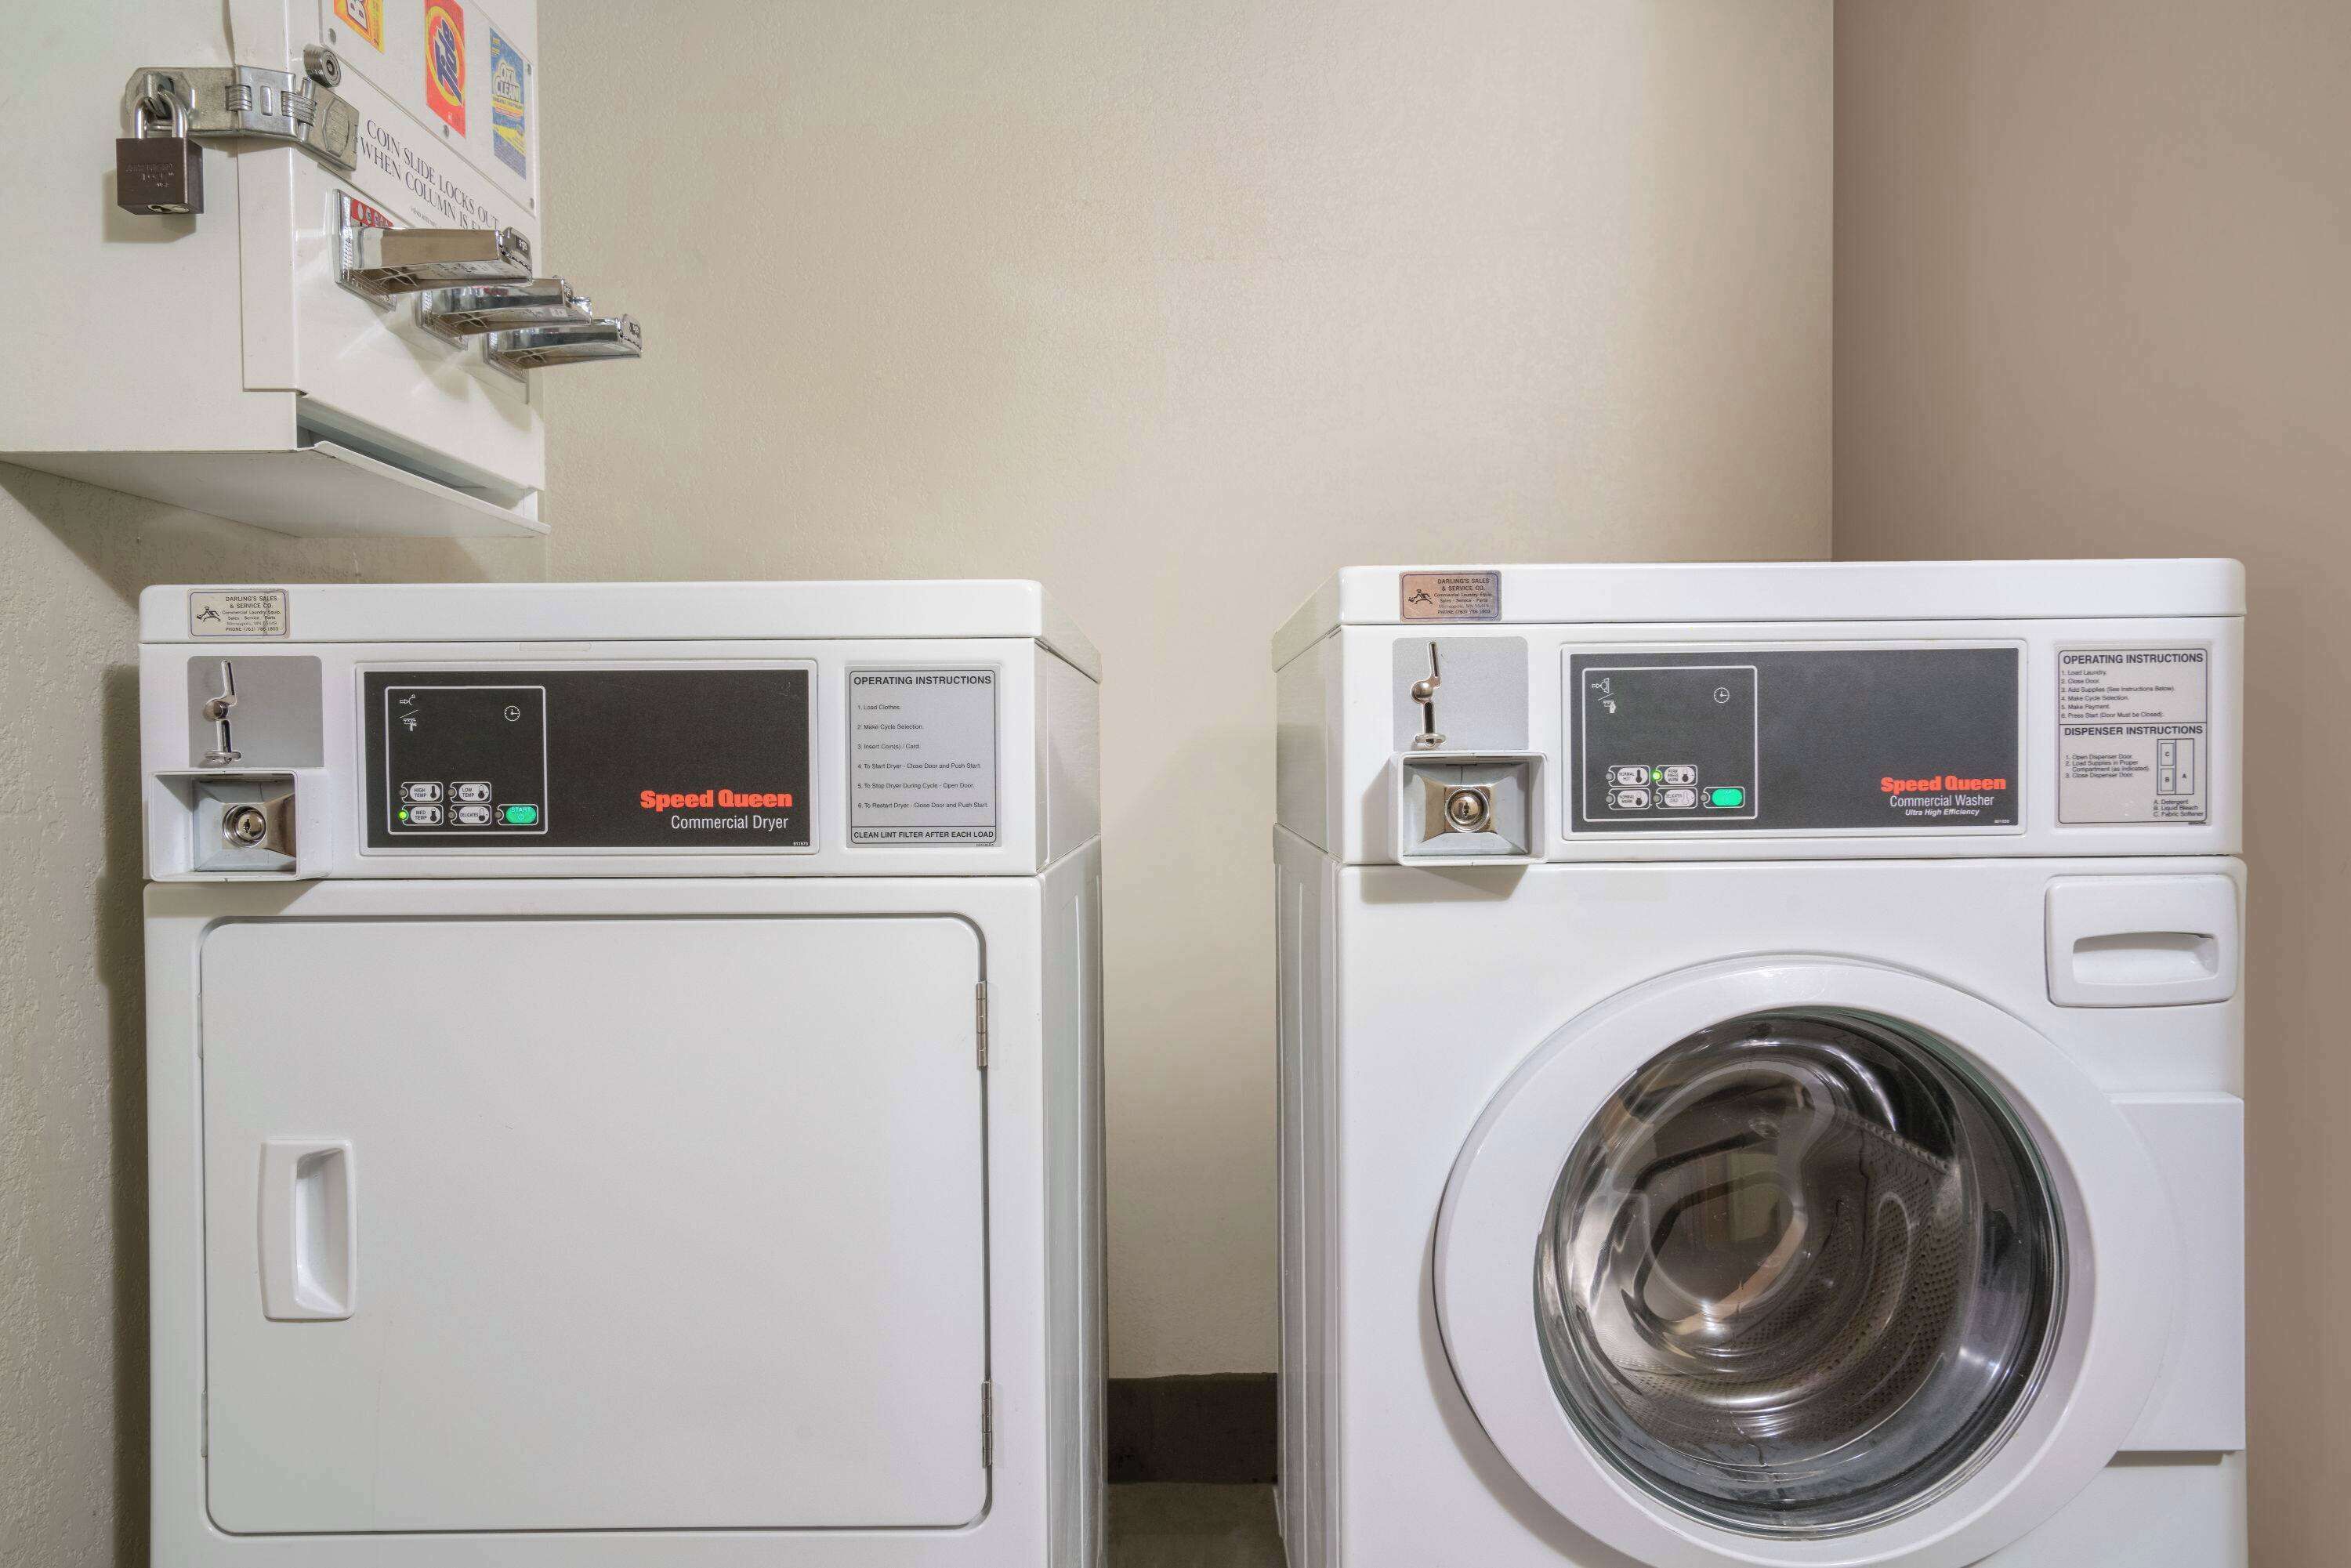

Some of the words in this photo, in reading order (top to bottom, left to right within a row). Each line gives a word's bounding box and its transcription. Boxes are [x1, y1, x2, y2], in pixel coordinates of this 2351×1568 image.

[433, 17, 462, 105] Tide
[494, 75, 520, 102] CLEAN
[360, 135, 400, 181] WHEN
[406, 172, 455, 220] COLUMN
[459, 212, 468, 227] IS
[367, 119, 400, 157] COIN
[404, 147, 435, 185] SLIDE
[439, 175, 475, 214] LOCKS
[478, 206, 498, 229] OUT
[2063, 654, 2123, 664] OPERATING
[2126, 654, 2203, 663] INSTRUCTIONS
[853, 676, 913, 685] OPERATING
[915, 675, 991, 684] INSTRUCTIONS
[2126, 726, 2203, 735] INSTRUCTIONS
[1881, 776, 1942, 795] Speed
[1945, 776, 2006, 790] Queen
[640, 790, 713, 813] Speed
[718, 789, 792, 808] Queen
[1889, 795, 1952, 807] Commercial
[1955, 795, 1994, 806] Washer
[671, 815, 748, 829] Commercial
[752, 815, 788, 831] Dryer
